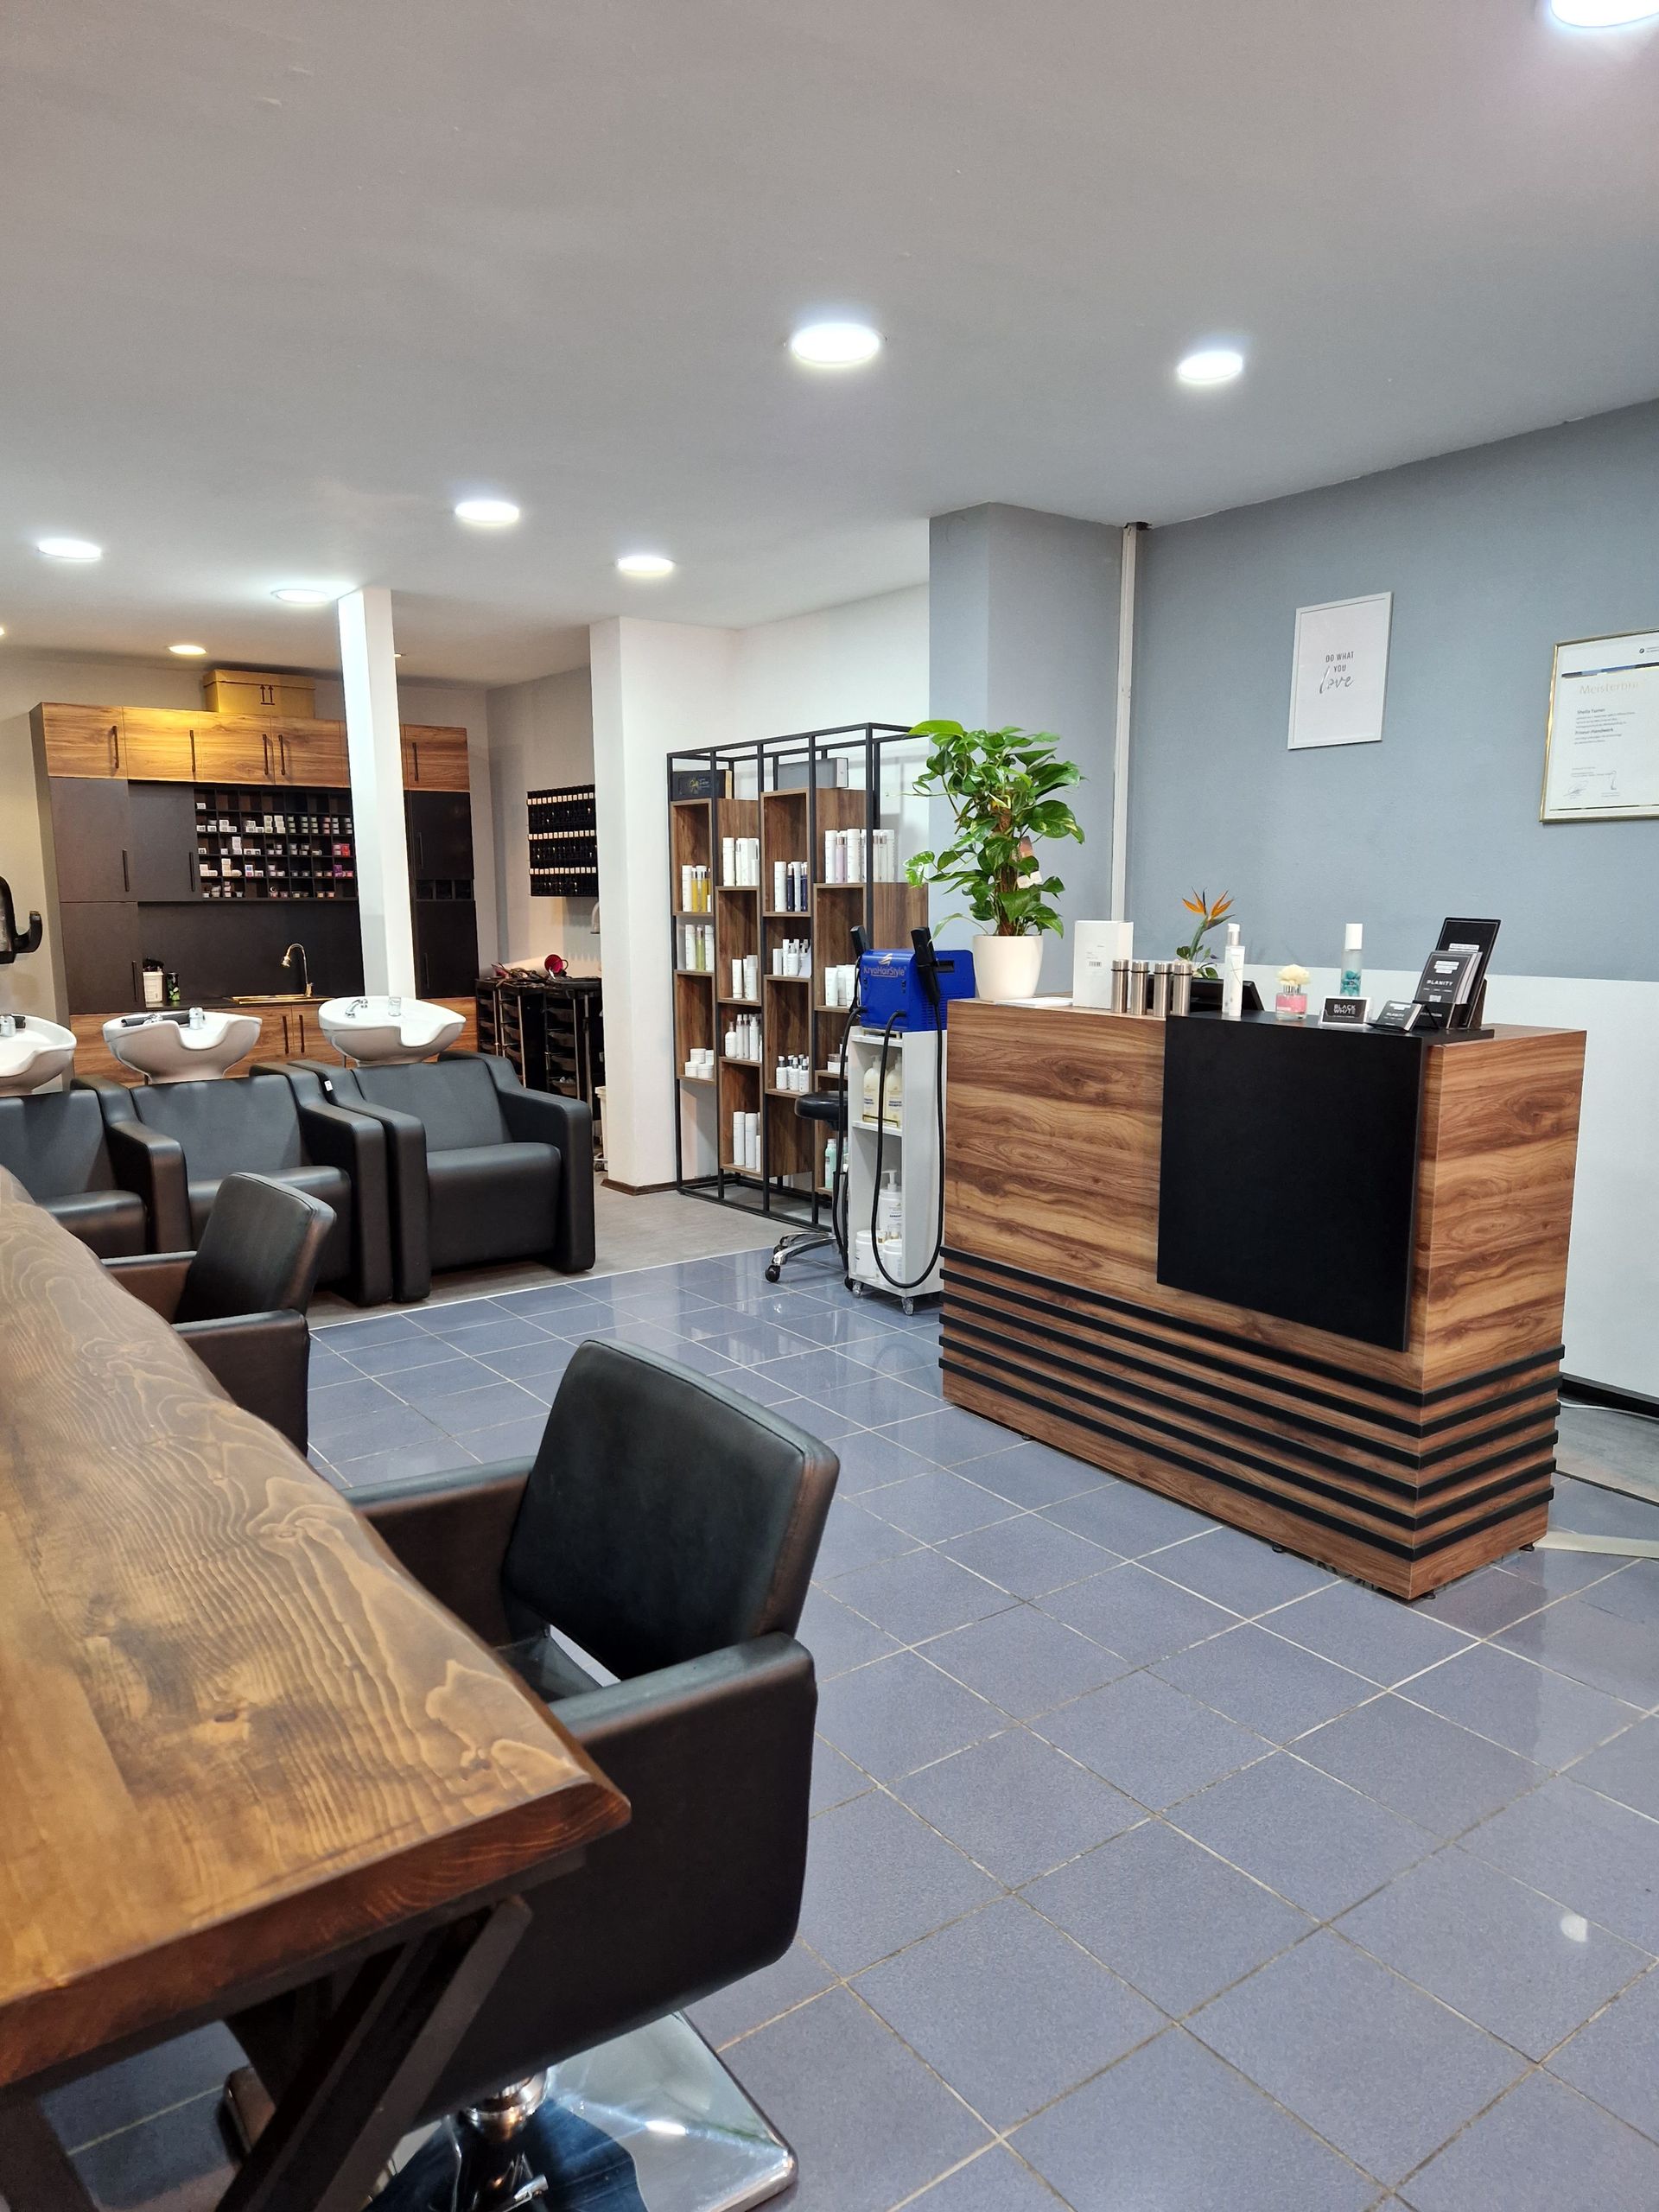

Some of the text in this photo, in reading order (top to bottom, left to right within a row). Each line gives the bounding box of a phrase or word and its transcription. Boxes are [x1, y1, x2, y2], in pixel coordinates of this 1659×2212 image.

[1325, 651, 1354, 663] DO WHAT
[1333, 664, 1346, 673] YOU
